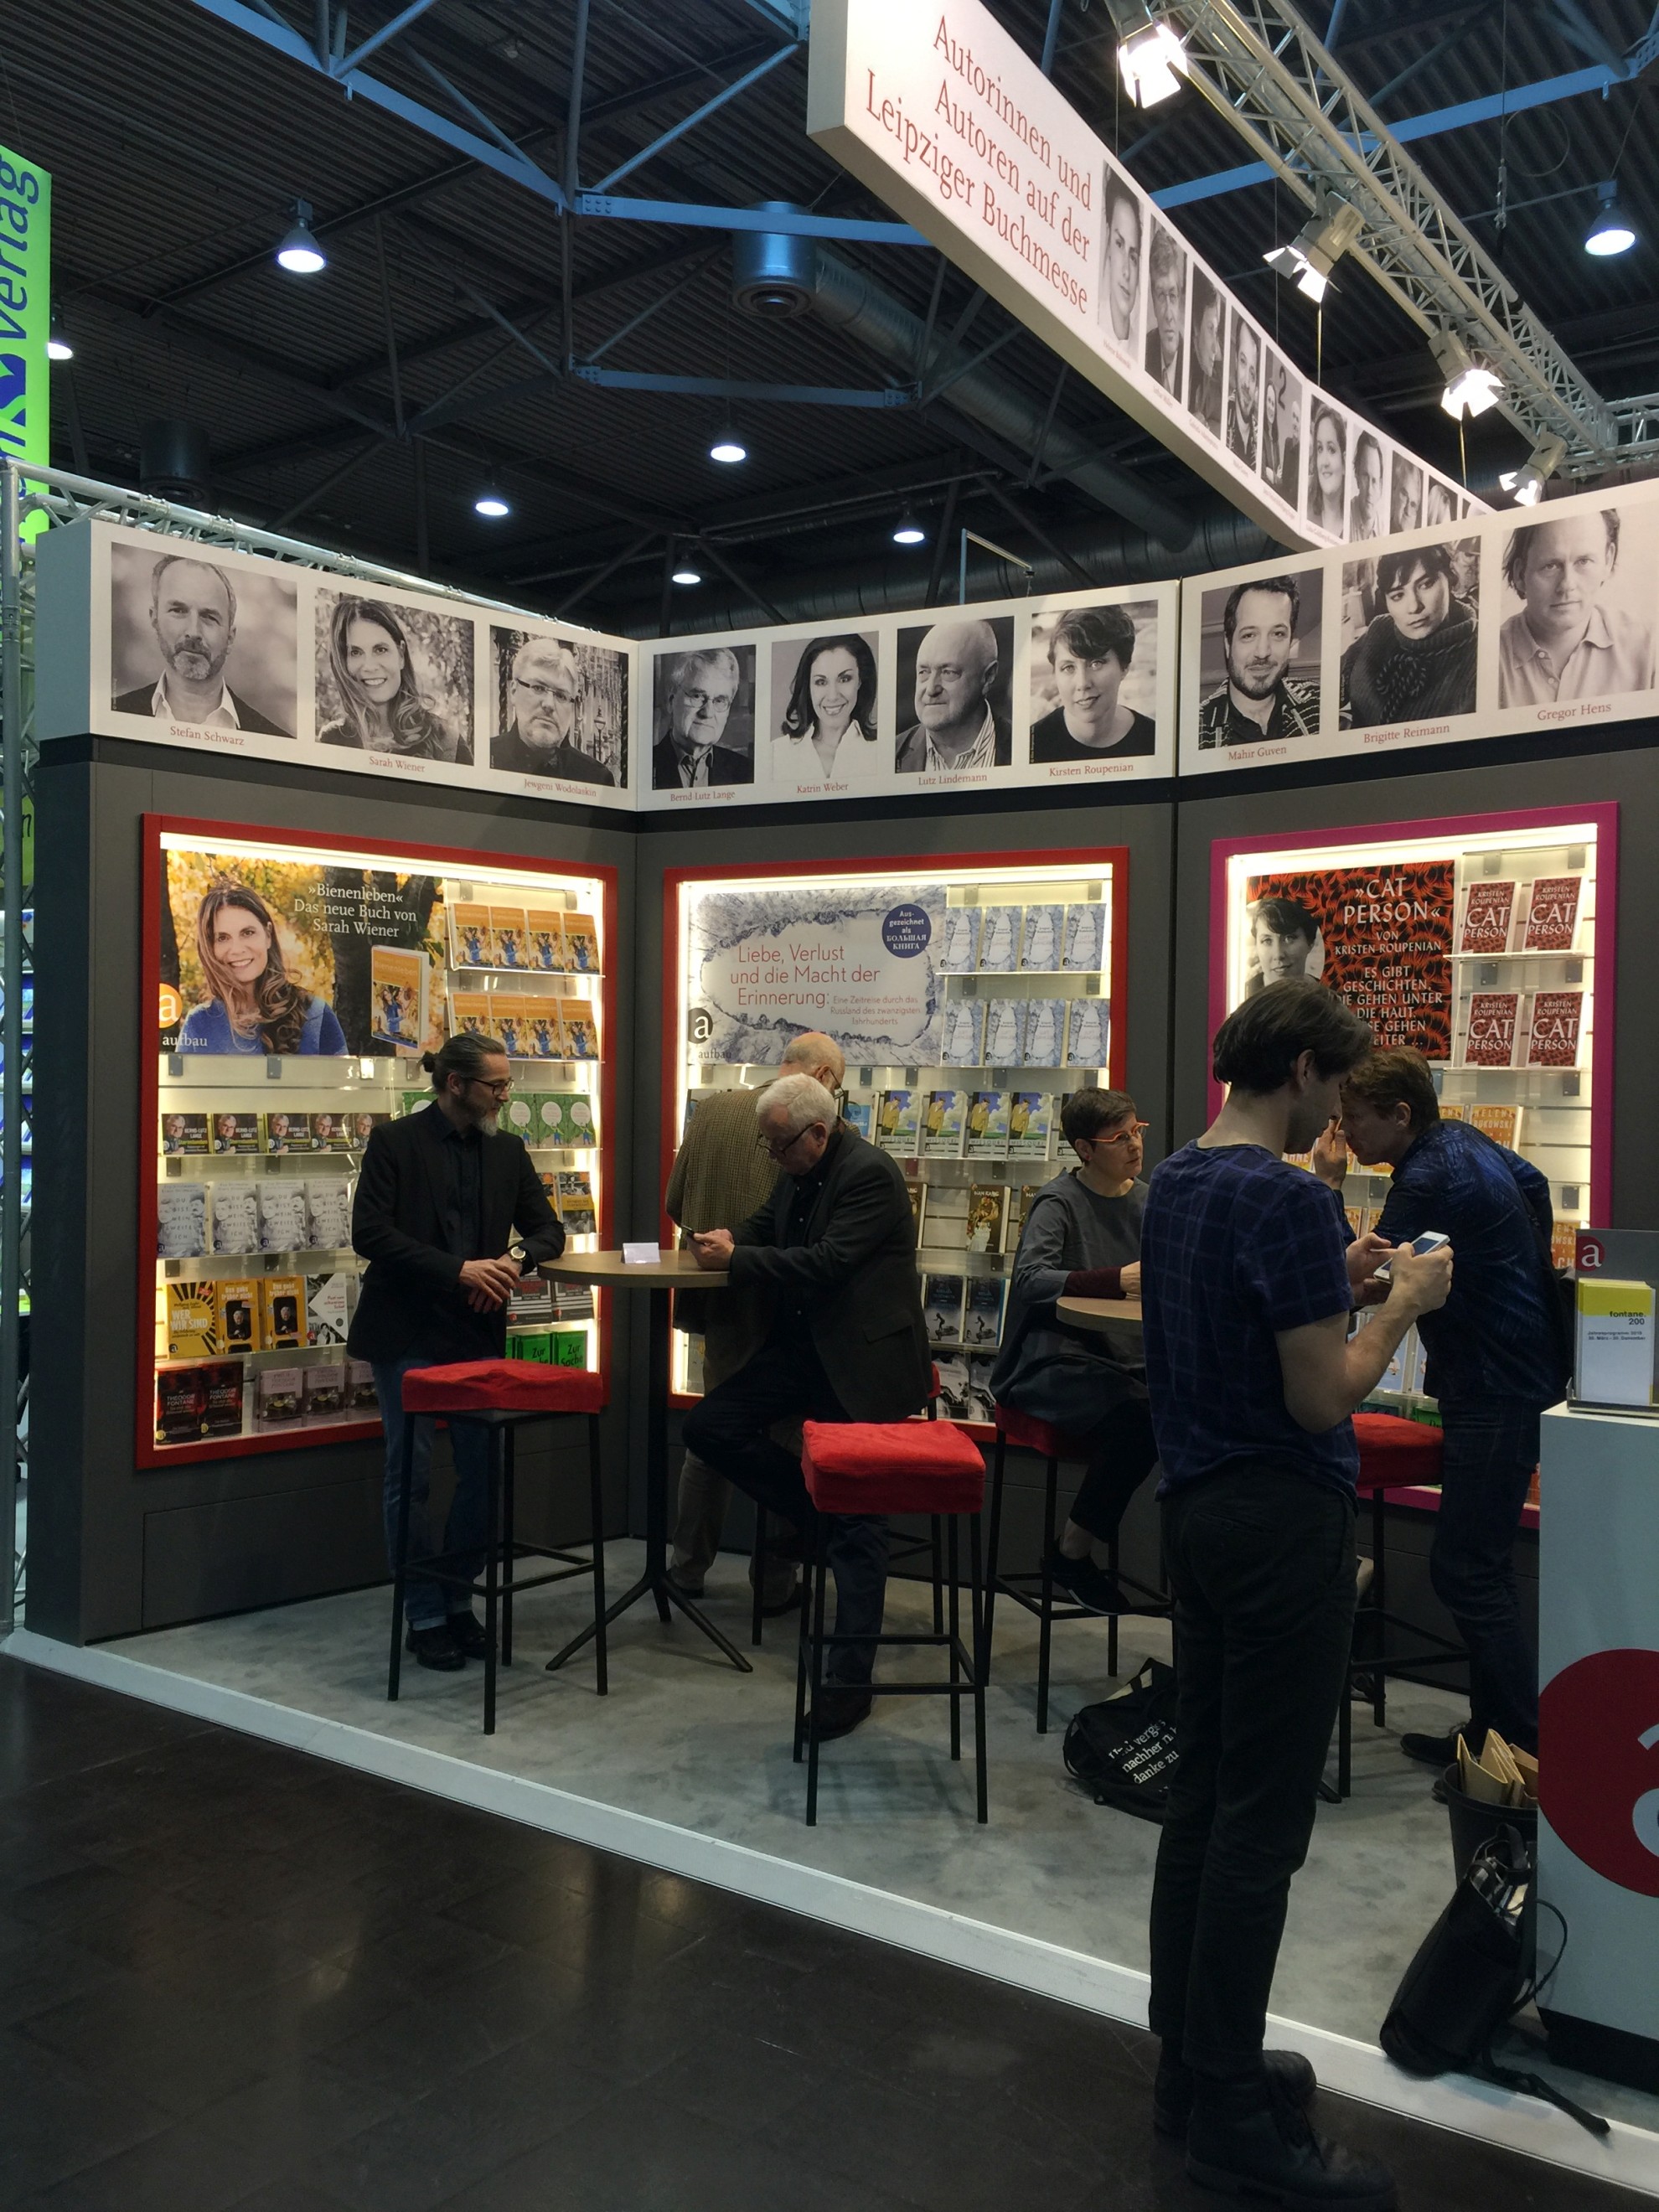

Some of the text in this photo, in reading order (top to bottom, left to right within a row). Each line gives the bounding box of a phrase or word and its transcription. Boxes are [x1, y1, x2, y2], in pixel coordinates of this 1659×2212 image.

[933, 15, 1092, 211] Autorinnen und
[934, 80, 1090, 262] Autoren auf der
[866, 69, 1088, 315] Leipziger Buchmesse
[1537, 701, 1612, 722] Gregor Hens
[170, 726, 245, 747] Stefan Schwarz
[1363, 723, 1450, 744] Brigitte Reimann
[1228, 747, 1287, 761] Mahir Guven
[370, 756, 426, 773] Sarah Wiener
[1084, 762, 1134, 777] Roupenian
[524, 778, 553, 793] Jewgeni
[918, 773, 987, 786] Lutz Lindemann
[713, 790, 736, 800] Lange
[797, 783, 849, 794] Katrin Weber
[308, 882, 404, 903] »Bienenleben«
[1471, 897, 1510, 905] ROUPENIAN
[294, 899, 417, 922] Das neue Buch von
[1466, 907, 1510, 928] CAT
[1531, 902, 1576, 923] CAT
[313, 918, 400, 938] Sarah Wiener
[889, 918, 924, 928] gezeichnet
[1528, 923, 1573, 935] PERSON
[1377, 931, 1398, 941] VON
[1465, 928, 1507, 938] PERSON
[738, 943, 845, 964] Liebe, Verlust
[1335, 941, 1441, 955] KRISTEN ROUPENIAN
[731, 964, 881, 985] und die Macht der
[1364, 966, 1411, 979] ES GIBT
[738, 987, 830, 1008] Erinnerung:
[833, 995, 918, 1004] Eine Zeitreise durch das
[1357, 994, 1397, 1005] GEHEN
[1402, 992, 1443, 1004] UNTER
[159, 994, 179, 1022] a
[831, 1006, 861, 1015] Russland
[877, 1007, 921, 1016] zwanzigsten
[1357, 1008, 1376, 1019] DIE
[695, 1016, 711, 1039] a
[1385, 1021, 1426, 1032] GEHEN
[1470, 1019, 1514, 1039] CAT
[1533, 1018, 1579, 1039] CAT
[163, 1033, 208, 1047] aufbau
[1374, 1034, 1405, 1046] EITER
[1468, 1039, 1512, 1051] PERSON
[1531, 1039, 1577, 1050] PERSON
[698, 1047, 731, 1059] aufbau
[1474, 1109, 1513, 1118] HELENE
[1582, 1244, 1602, 1267] a
[171, 1309, 191, 1320] WER
[170, 1318, 209, 1331] WIR SIND
[532, 1347, 545, 1358] Zur
[568, 1344, 581, 1355] Zur
[1122, 1741, 1163, 1773] nachher
[1133, 1750, 1180, 1784] danke zu
